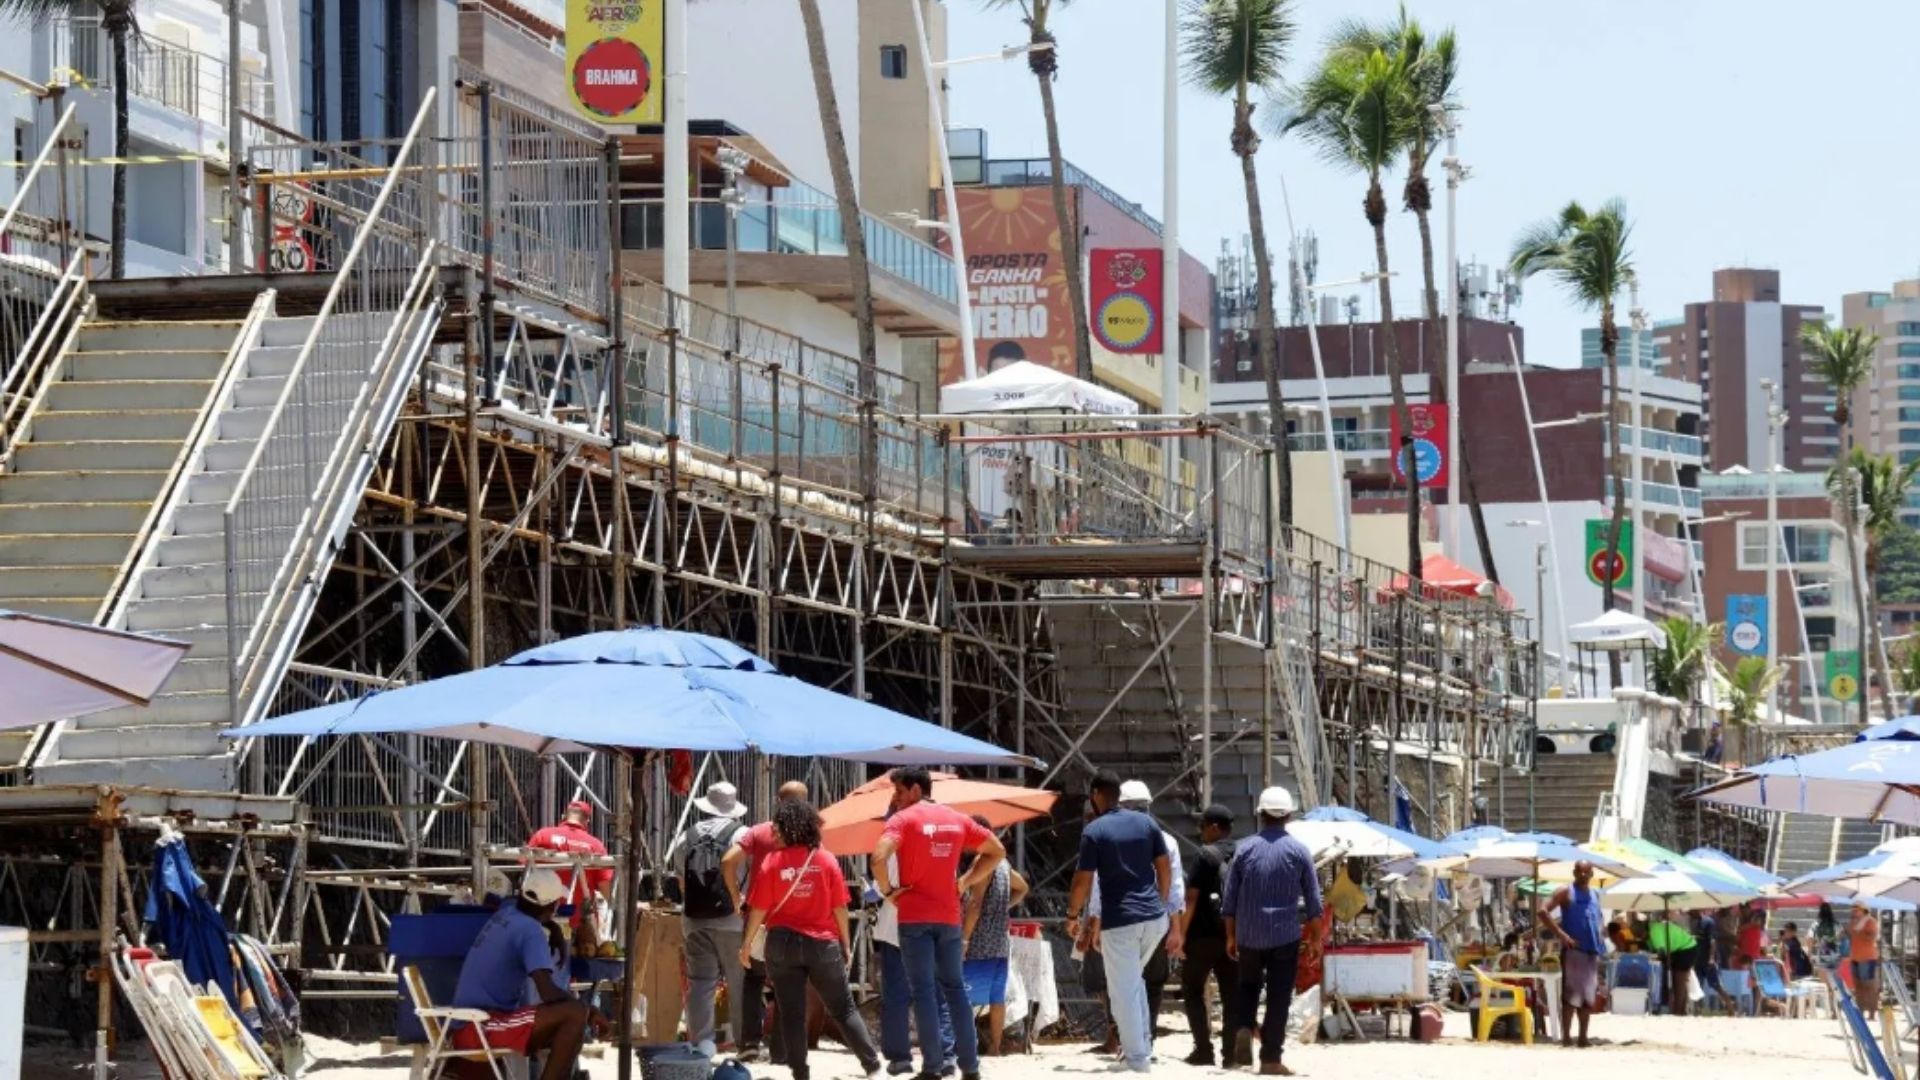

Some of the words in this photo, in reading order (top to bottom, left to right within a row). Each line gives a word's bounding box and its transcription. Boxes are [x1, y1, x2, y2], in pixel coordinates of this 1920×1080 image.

[585, 69, 638, 85] BRAHMA
[967, 253, 1048, 269] APOSTA
[970, 268, 1042, 284] GANHA
[980, 284, 1037, 304] APOSTA
[969, 304, 1048, 339] VERÃO
